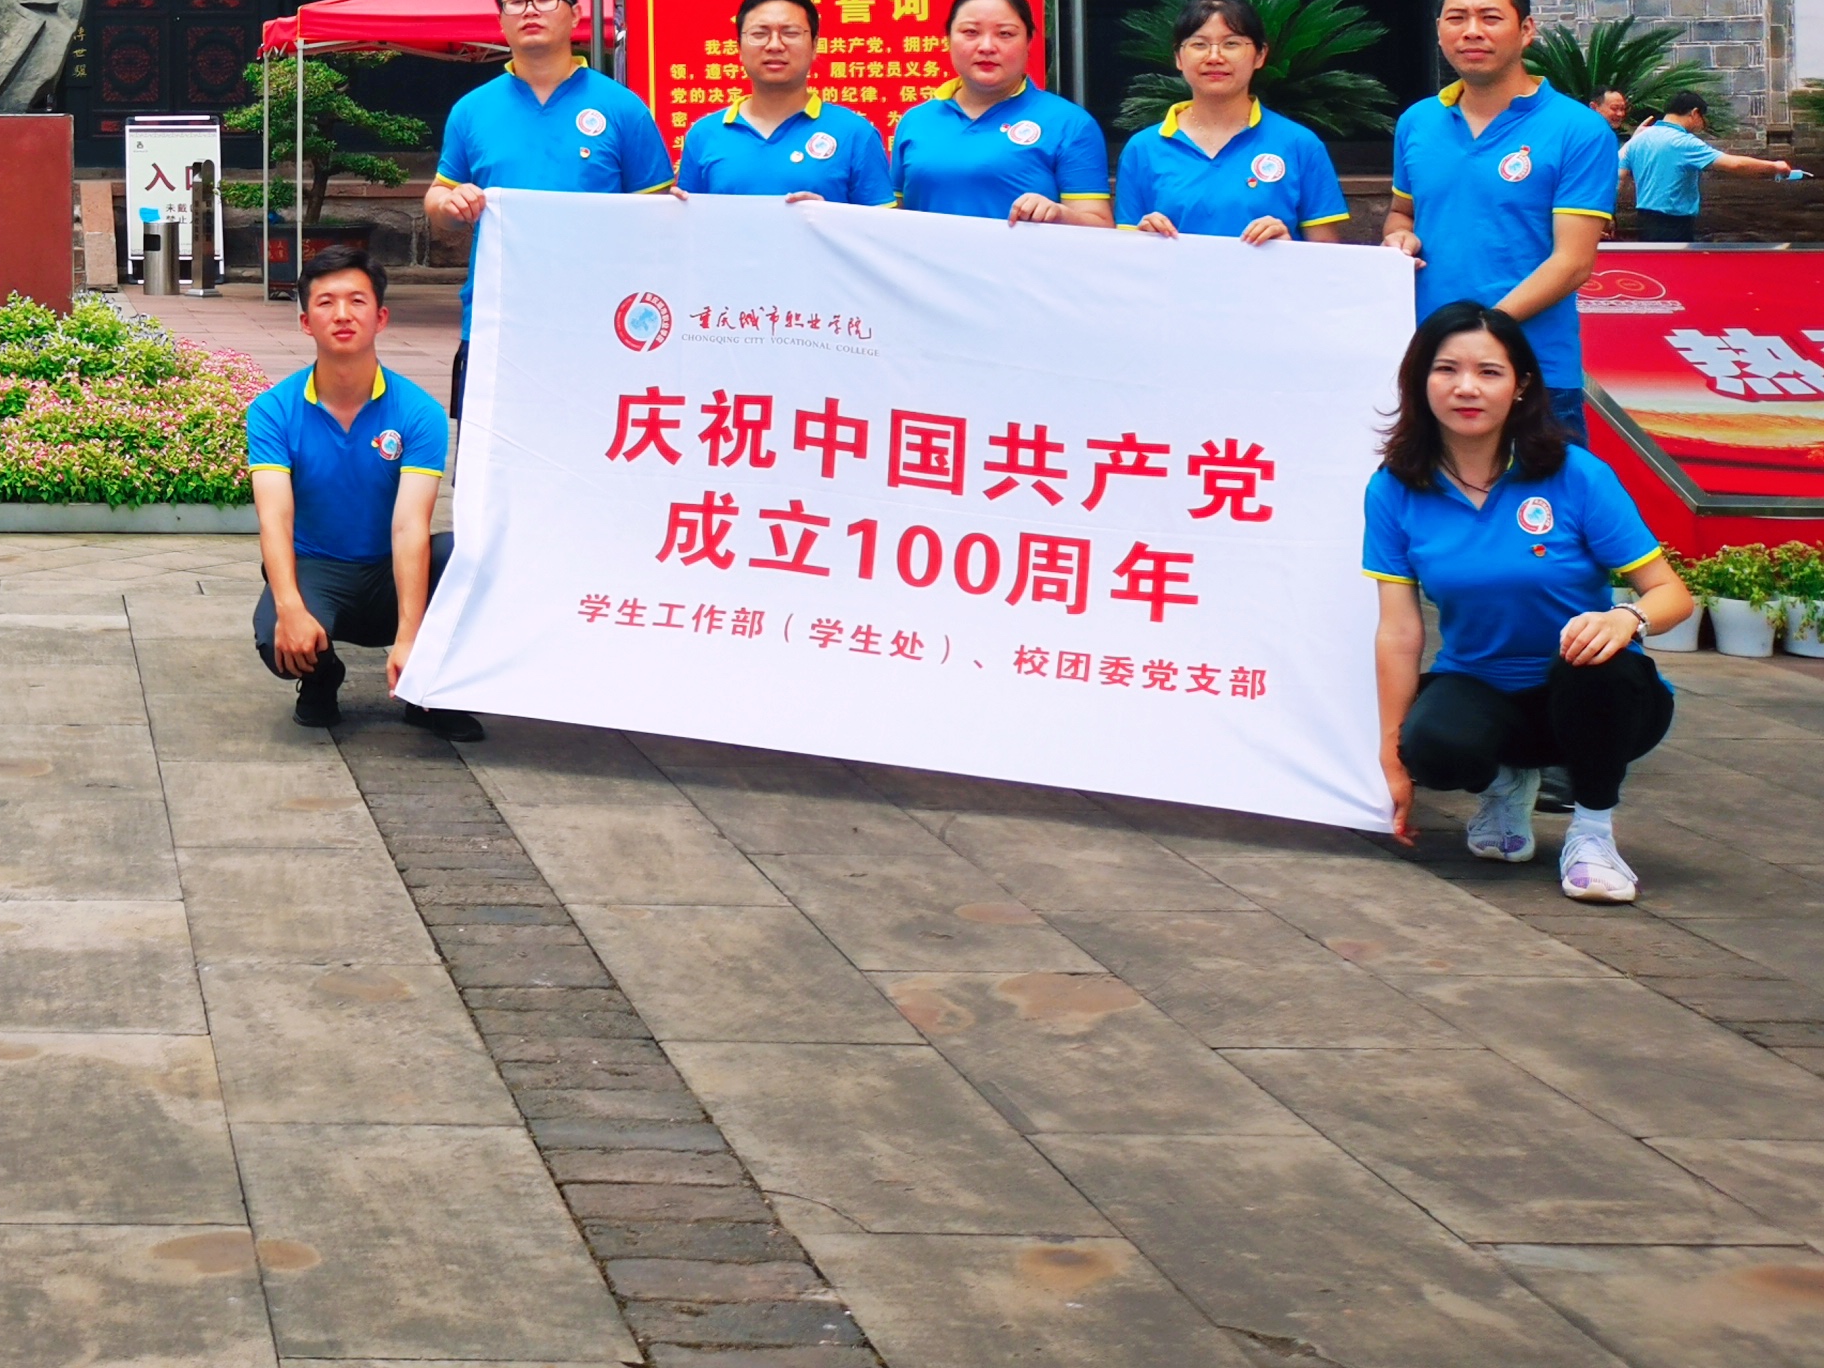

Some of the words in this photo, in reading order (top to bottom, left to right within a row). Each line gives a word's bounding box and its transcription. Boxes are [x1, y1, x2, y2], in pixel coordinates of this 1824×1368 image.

[681, 333, 740, 345] CHONGQING
[744, 336, 765, 345] CITY
[771, 336, 832, 351] VOCATIONAL
[836, 343, 880, 357] COLLEGE
[689, 305, 872, 340] 重庆城市职业学院
[1663, 327, 1824, 396] 热
[605, 385, 1277, 524] 庆祝中国共产党
[654, 489, 1201, 624] 成立100周年
